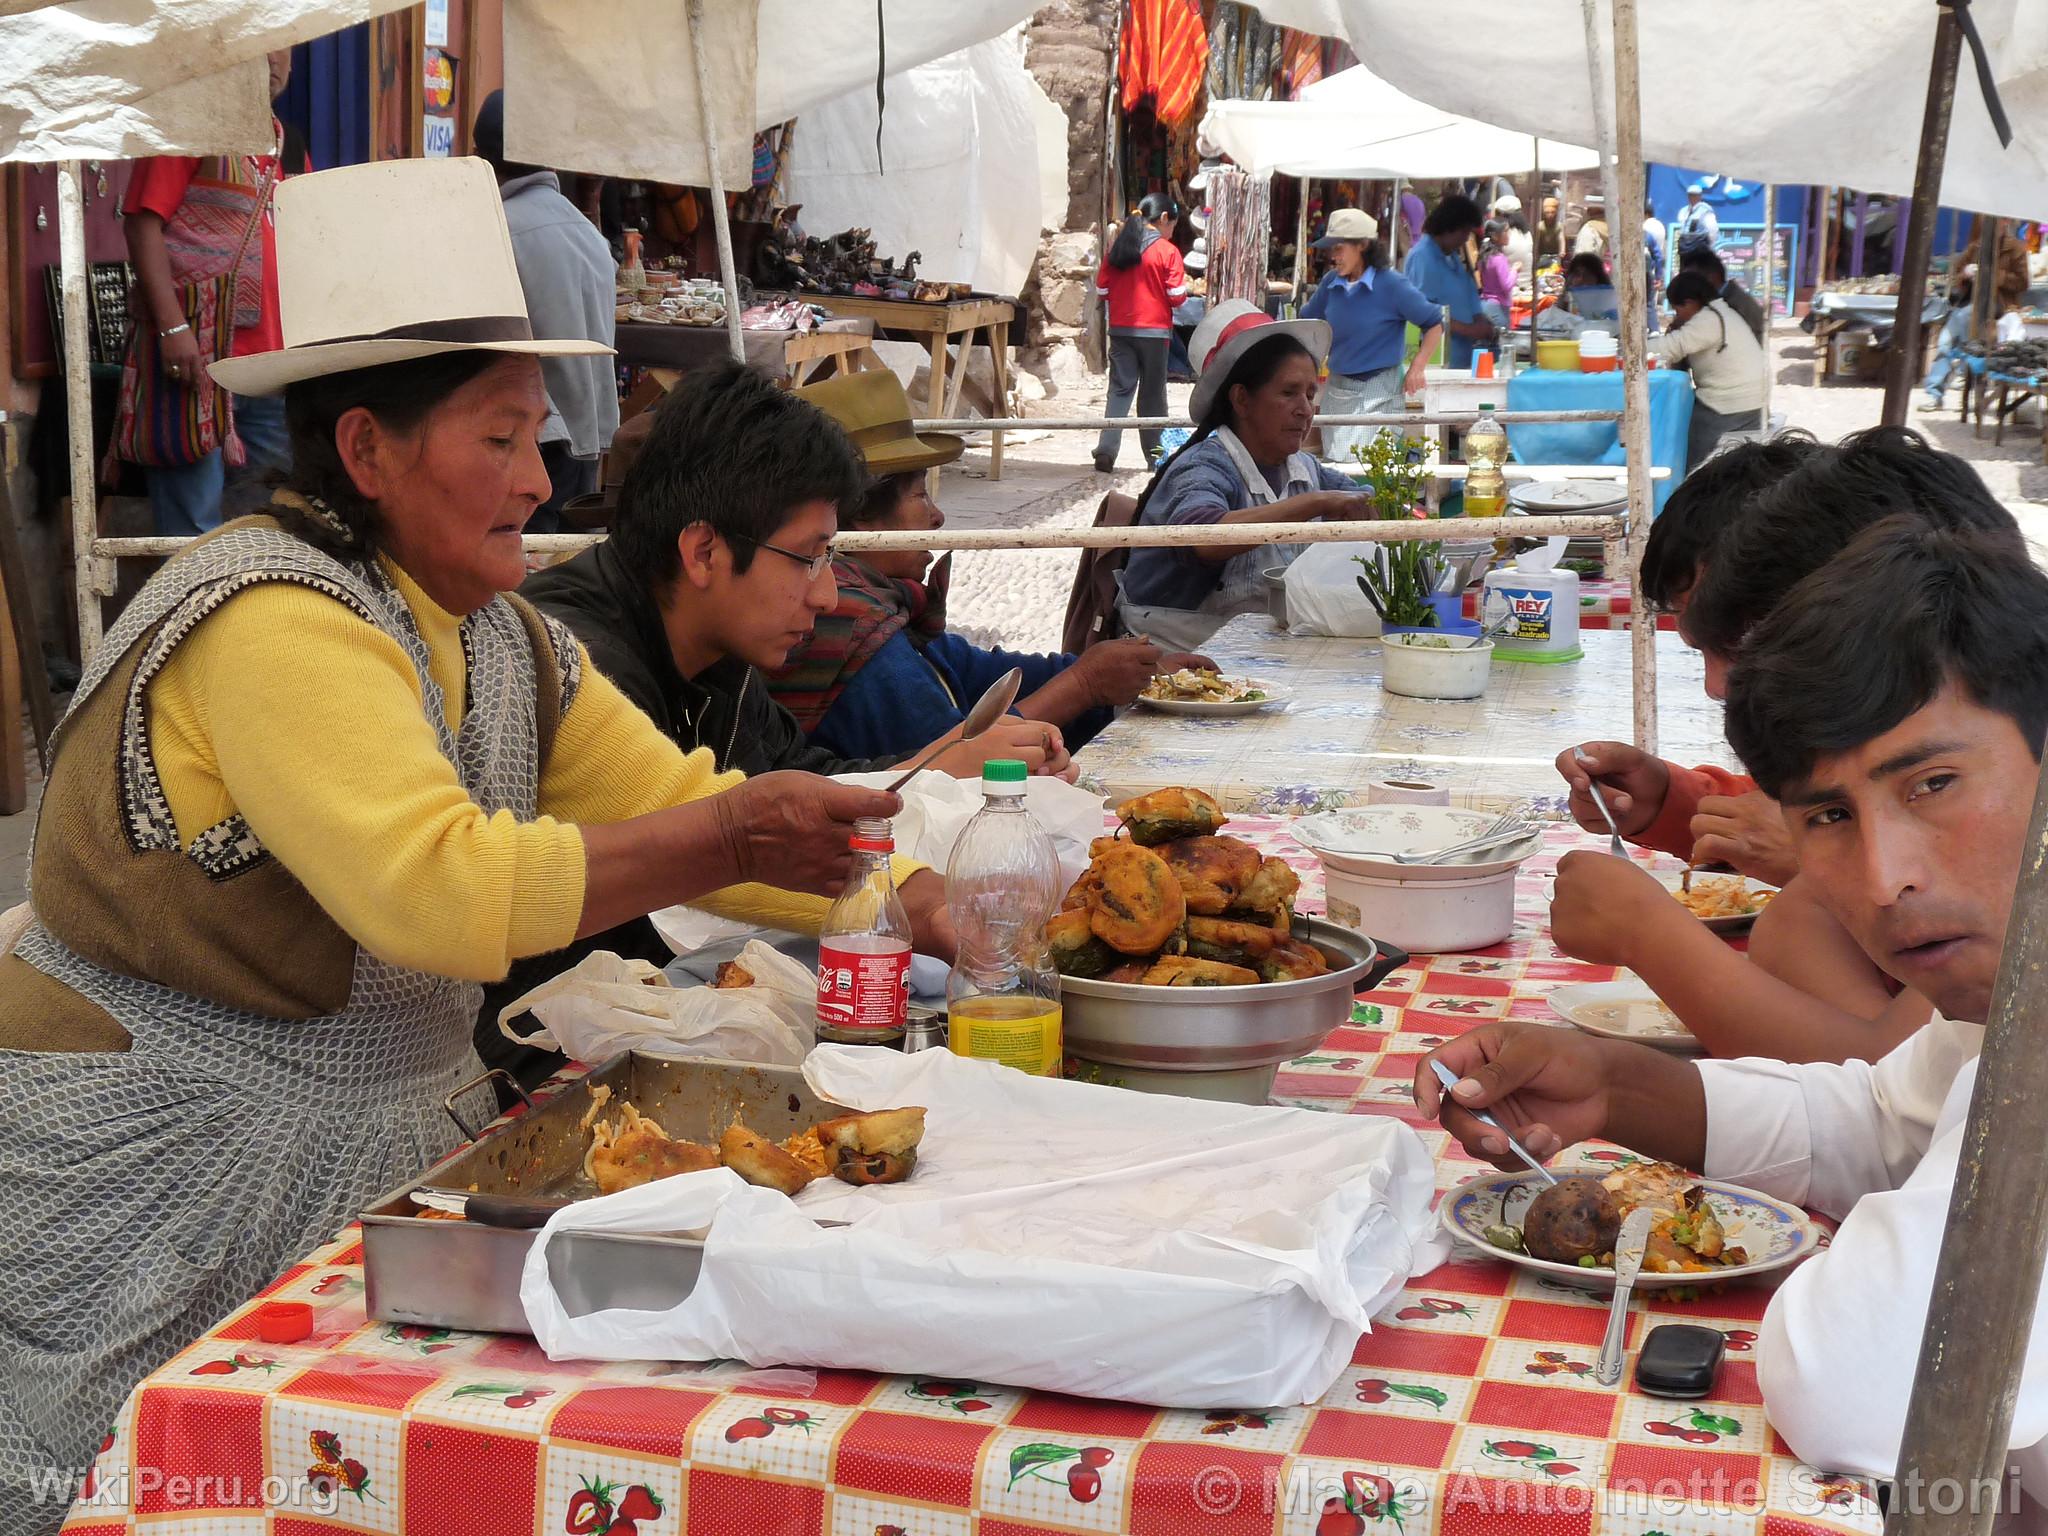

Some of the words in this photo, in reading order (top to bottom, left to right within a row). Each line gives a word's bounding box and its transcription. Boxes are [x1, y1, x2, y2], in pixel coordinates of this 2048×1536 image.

[426, 124, 451, 151] VISA
[1516, 600, 1544, 612] REY
[1514, 631, 1550, 639] Cuadrado
[833, 1013, 843, 1022] 500
